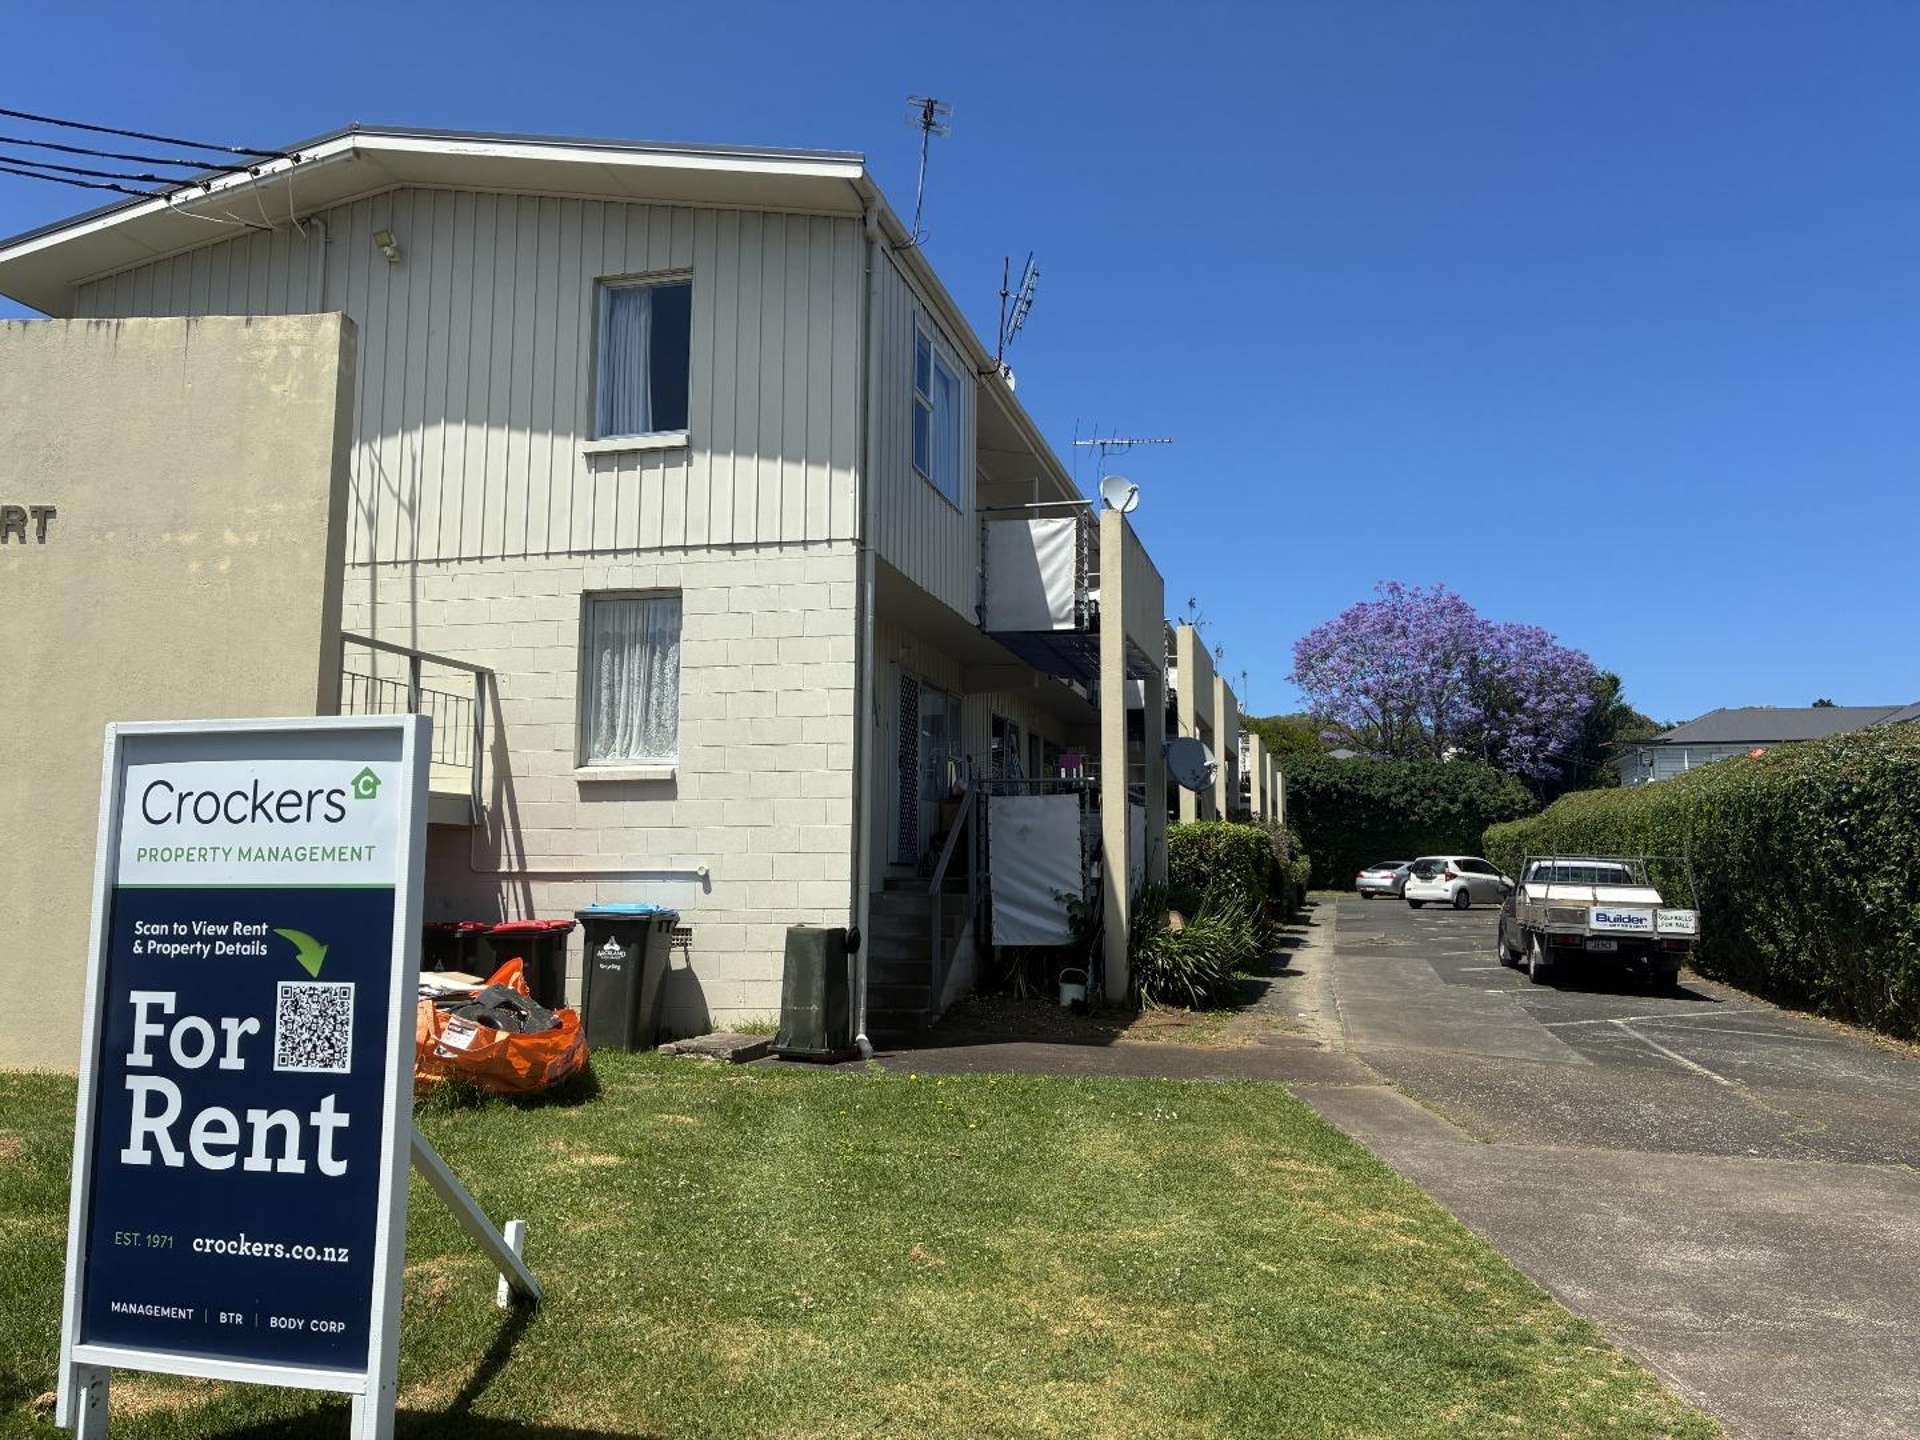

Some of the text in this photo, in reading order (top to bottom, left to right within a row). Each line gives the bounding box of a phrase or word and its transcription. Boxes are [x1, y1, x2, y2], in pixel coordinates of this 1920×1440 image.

[142, 778, 346, 825] Crockers
[136, 844, 377, 863] PROPERTY MANAGEMENT
[134, 921, 268, 936] Scan to View Rent
[1595, 912, 1648, 925] Builder
[133, 940, 268, 958] & Property Details
[126, 990, 260, 1071] For
[120, 1075, 350, 1177] Rent
[114, 1232, 174, 1249] EST. 1971
[192, 1234, 349, 1263] crockers.co.nz
[111, 1301, 346, 1333] MANAGEMENT BTR BODY CORP
